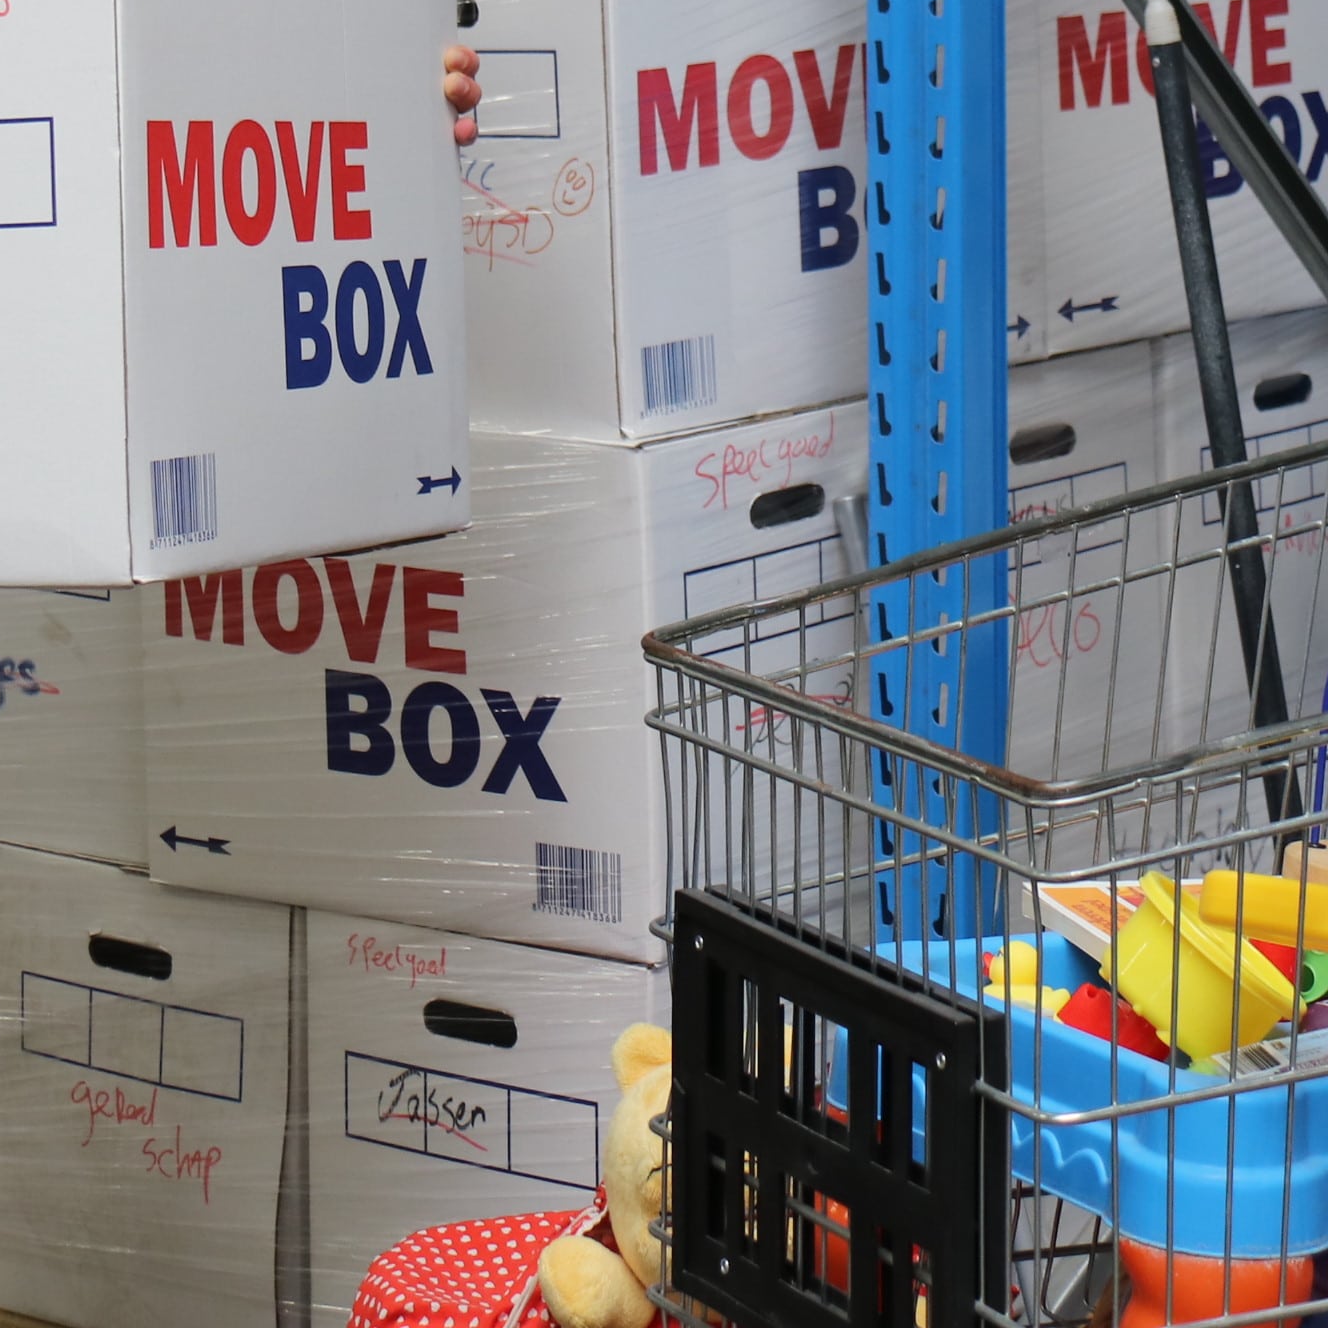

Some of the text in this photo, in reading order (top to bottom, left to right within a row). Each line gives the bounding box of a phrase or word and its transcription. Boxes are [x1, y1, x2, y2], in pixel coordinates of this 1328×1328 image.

[637, 43, 866, 177] MOV
[147, 119, 374, 249] MOVE
[281, 259, 433, 390] BOX
[164, 557, 468, 676] MOVE
[325, 668, 568, 803] BOX
